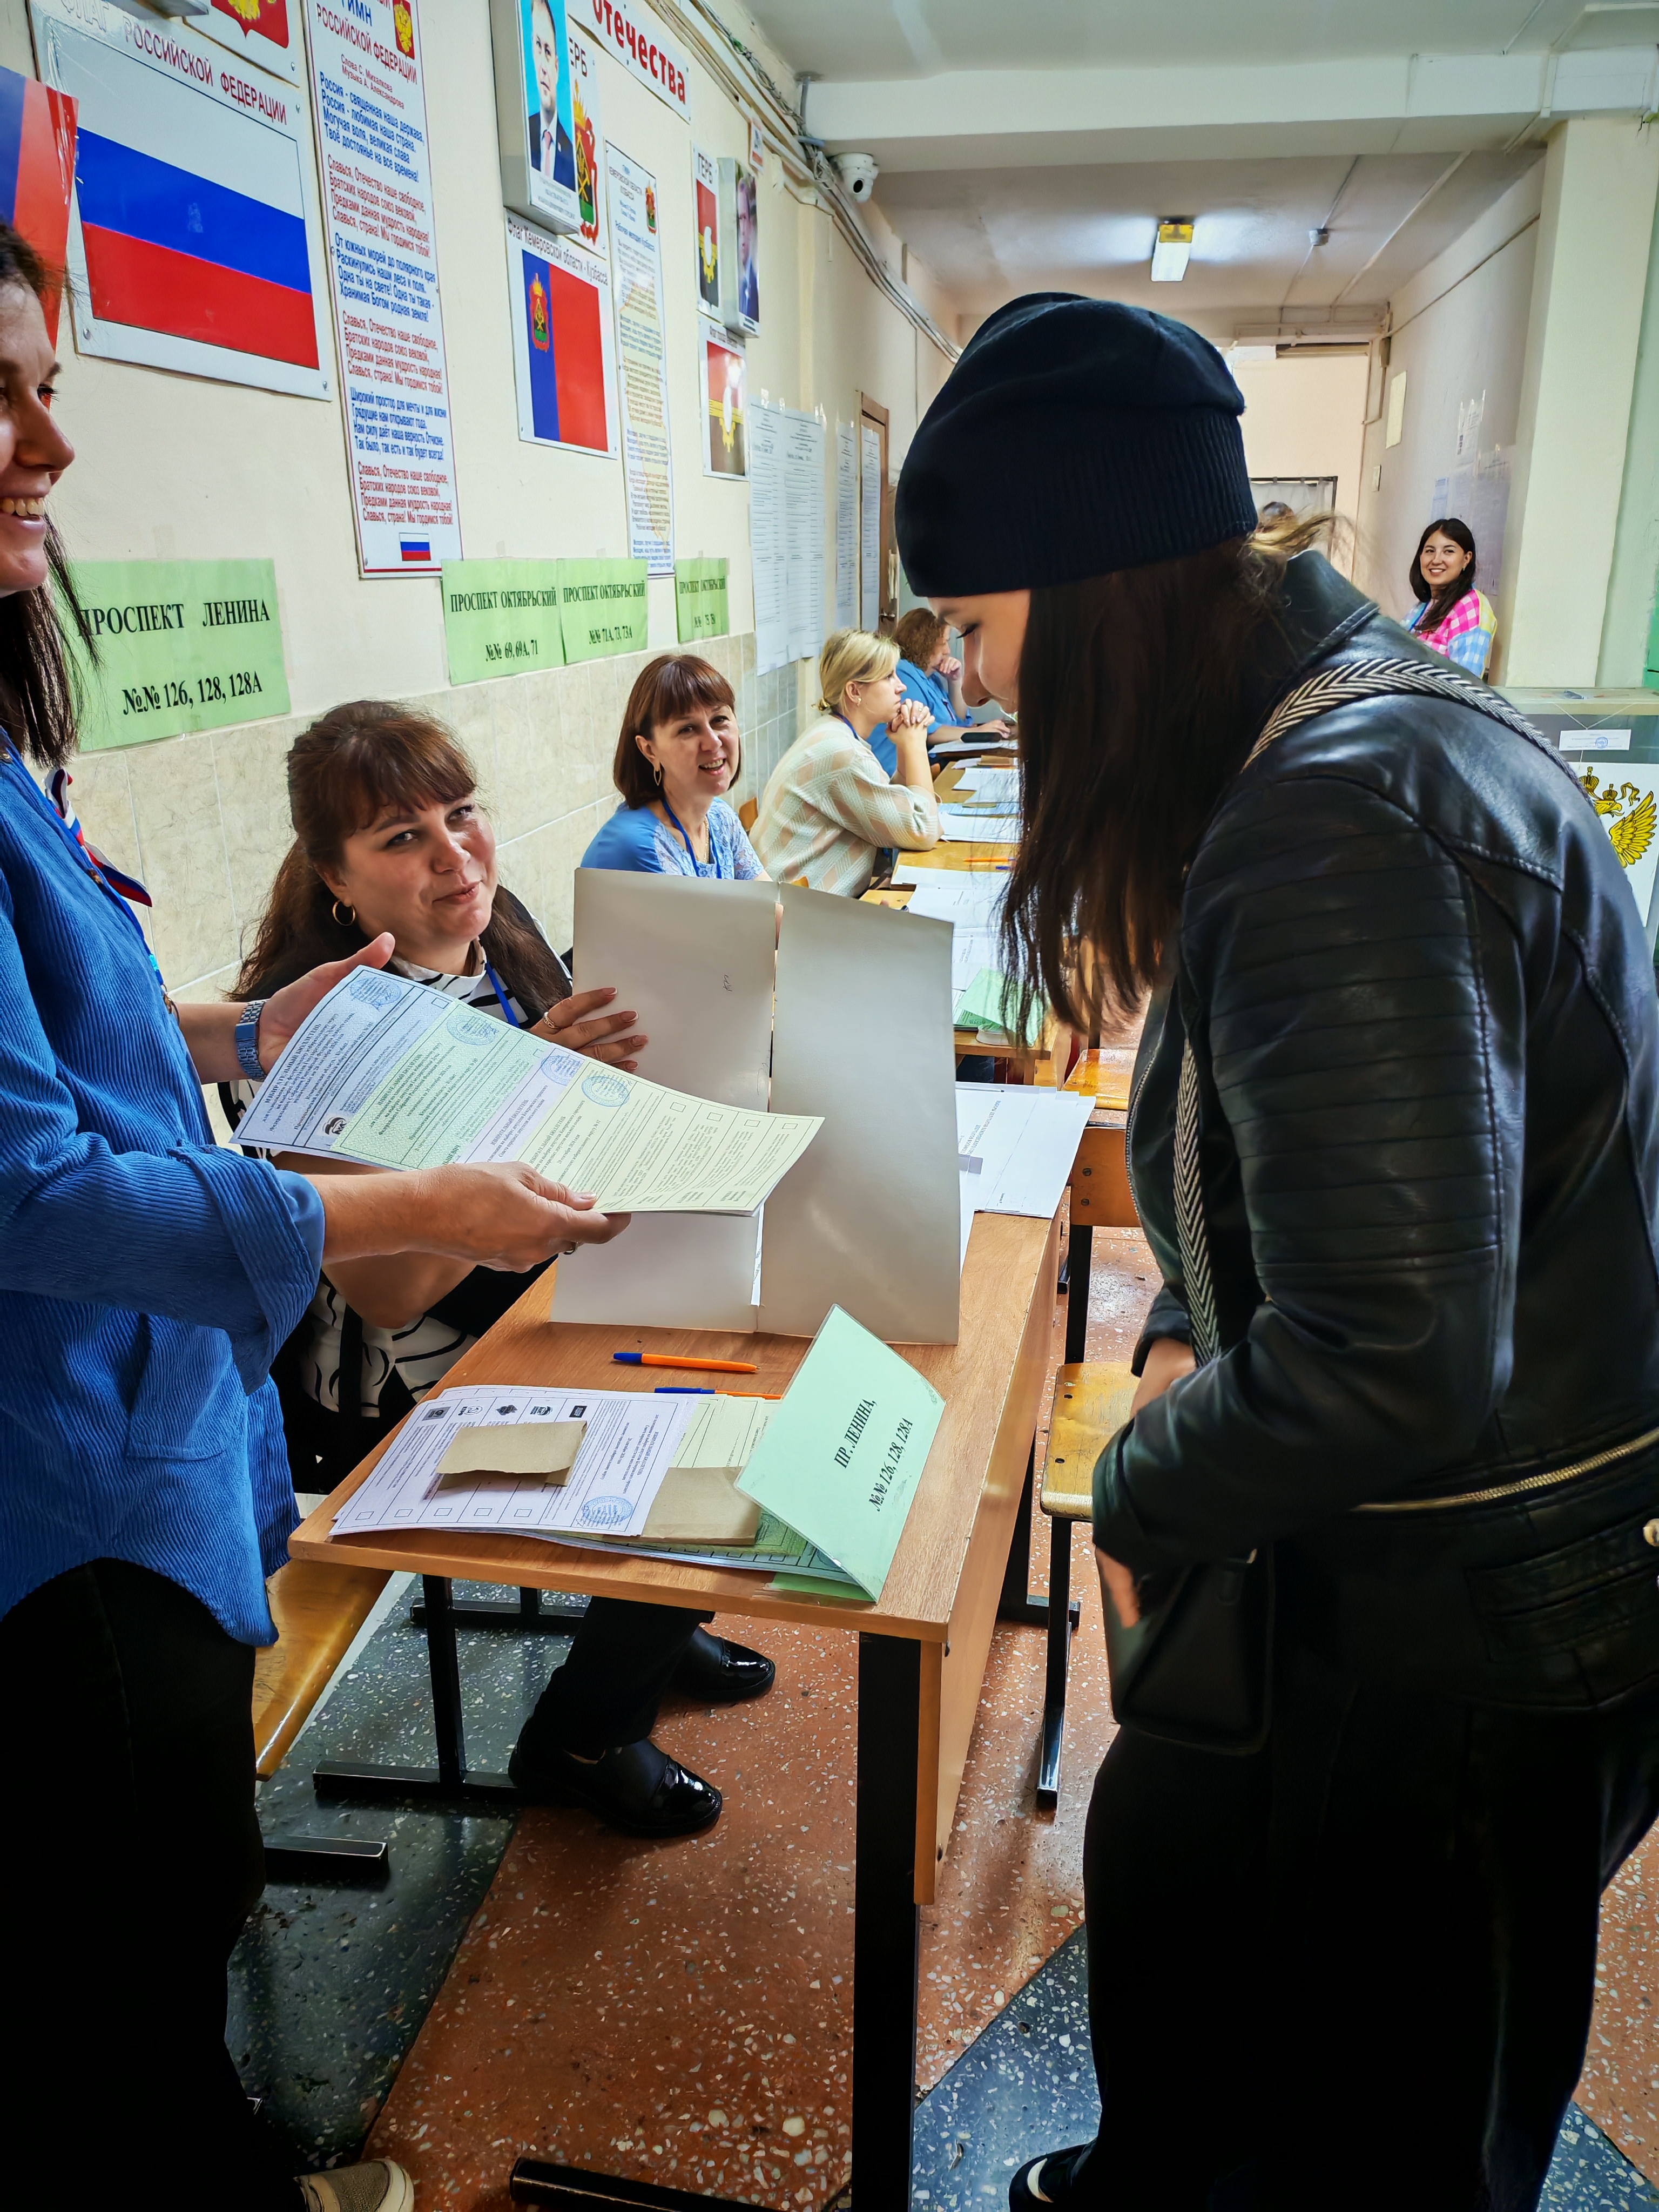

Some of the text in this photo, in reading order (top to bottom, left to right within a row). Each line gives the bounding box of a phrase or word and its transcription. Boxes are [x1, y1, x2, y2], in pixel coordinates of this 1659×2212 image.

[316, 2, 417, 85] РОССИЙСКОЙ ФЕДЕРАЦИИ
[122, 16, 213, 86] РОССИЙСКОЙ
[220, 72, 287, 125] ФЕДЕРАЦИИ
[320, 71, 343, 97] Россия
[321, 88, 345, 114] Россия
[323, 105, 350, 132] Могучая
[324, 122, 340, 143] Твоё
[335, 232, 343, 248] От
[338, 265, 355, 283] Одна
[450, 587, 557, 612] ПРОСПЕКТ ОКТЯБРЬСКИЙ
[563, 585, 598, 603] ПРОСПЕКТ
[203, 599, 270, 627] ЛЕНИНА
[485, 644, 502, 662] №№
[531, 640, 538, 655] 71
[122, 671, 262, 715] №№ 126, 128, 128А
[490, 1118, 514, 1145] ИЗБИРАТЕЛЬНЫЙ
[529, 1135, 552, 1163] ИЗБИРАТЕЛЬНЫЙ
[834, 1399, 878, 1468] ПР. ЛЕНИНА,
[869, 1417, 913, 1512] №№ 126, 128, 128А
